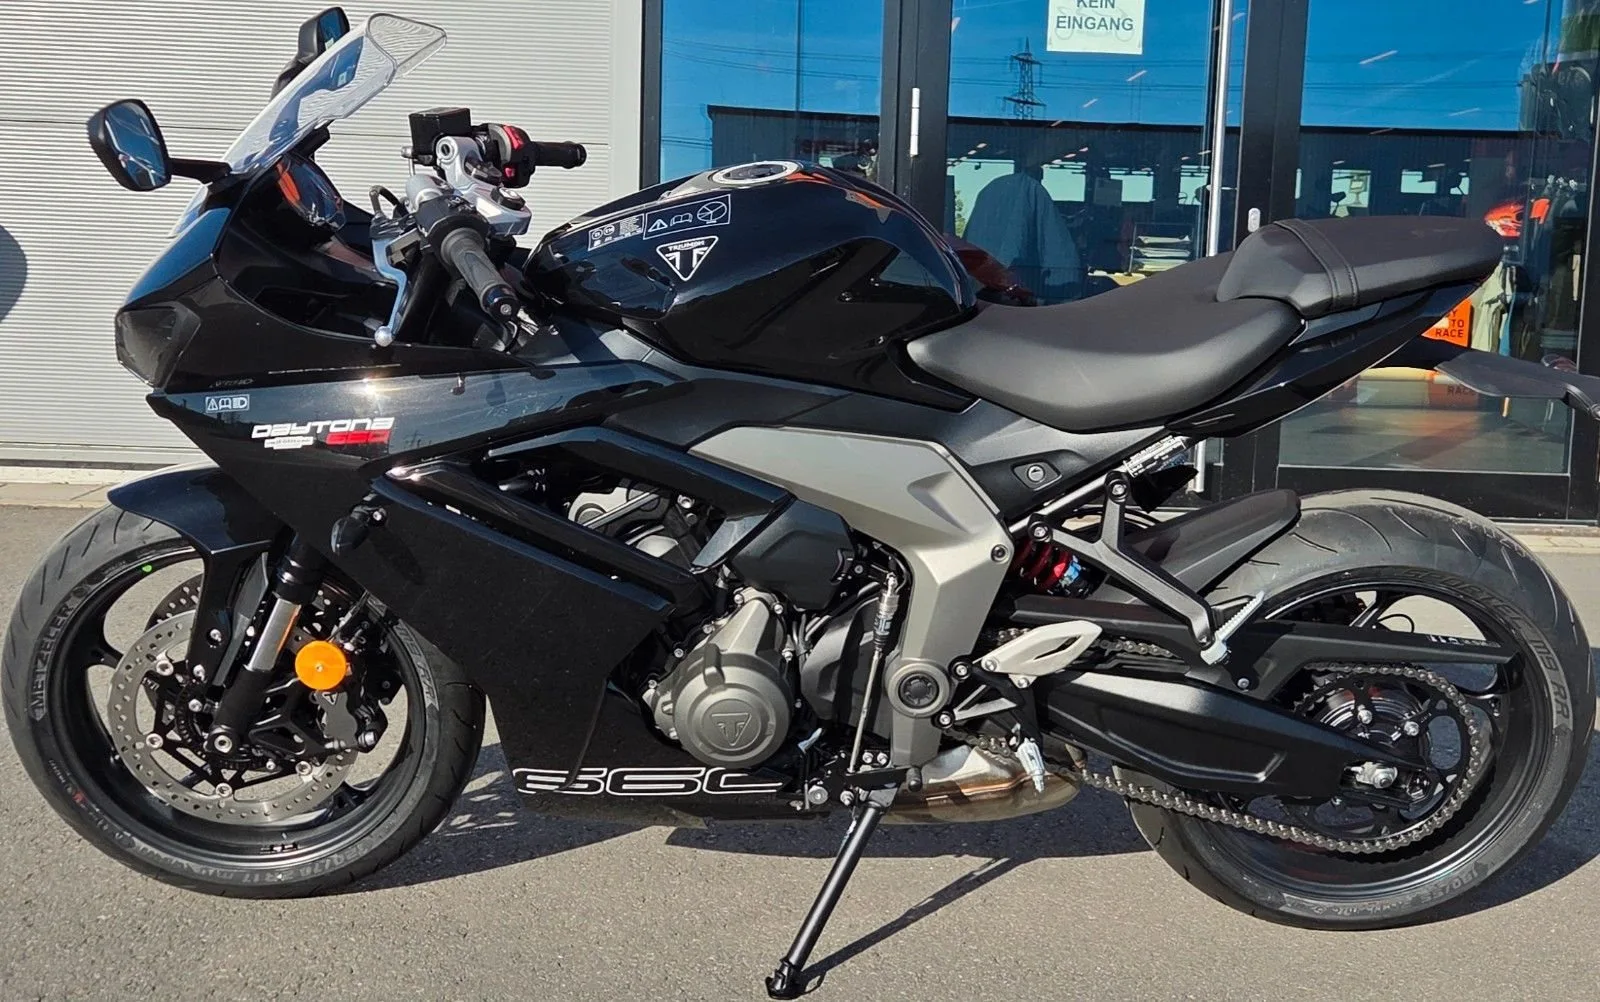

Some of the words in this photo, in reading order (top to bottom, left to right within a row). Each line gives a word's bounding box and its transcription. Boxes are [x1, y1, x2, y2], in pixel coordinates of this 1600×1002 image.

[1076, 0, 1116, 8] KEIN
[1056, 15, 1134, 31] EINGANG
[668, 240, 705, 252] TRIUMPH
[1452, 319, 1465, 328] TO
[1435, 328, 1464, 338] RACE
[29, 603, 75, 707] METZELER
